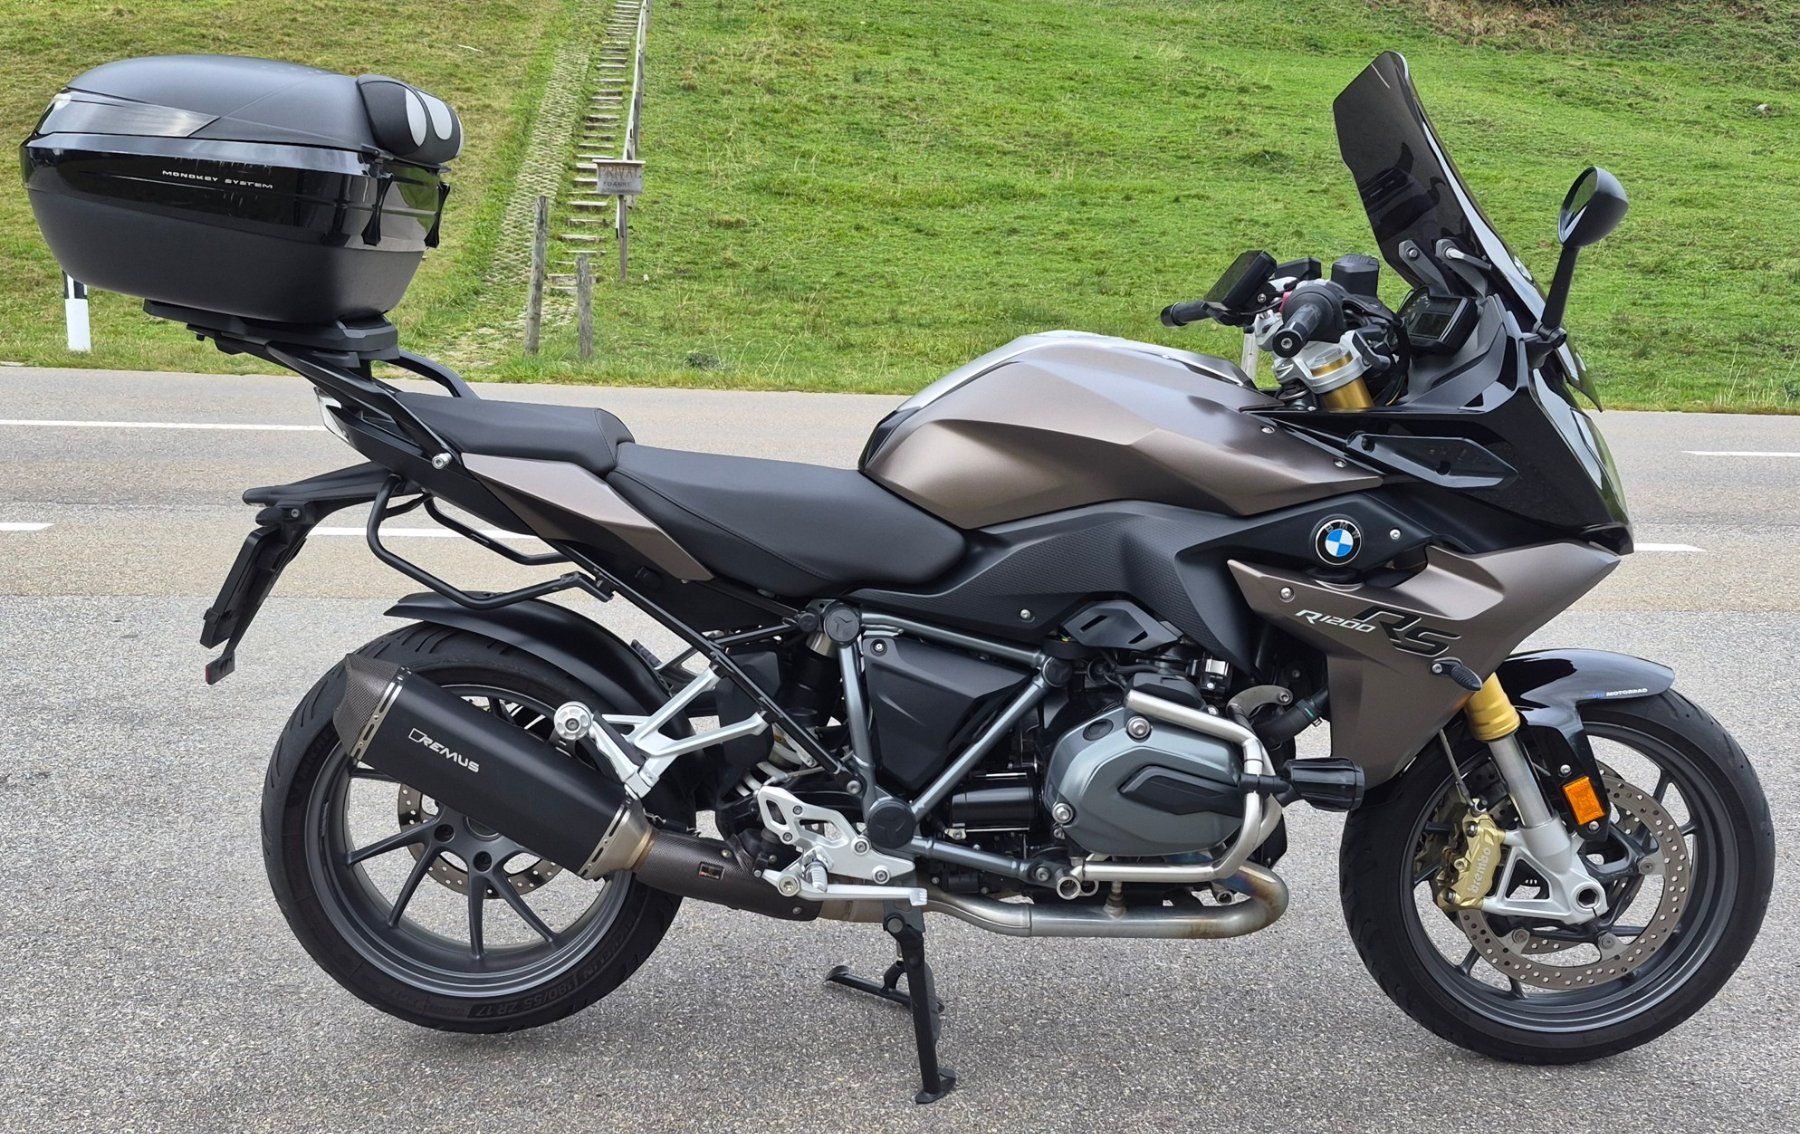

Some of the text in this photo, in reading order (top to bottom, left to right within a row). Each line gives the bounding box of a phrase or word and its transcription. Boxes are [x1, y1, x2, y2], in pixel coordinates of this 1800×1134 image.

[162, 170, 273, 189] MONOKEY SYSTEM
[1324, 521, 1361, 540] BMW
[1295, 605, 1462, 658] R1200 RS
[1606, 687, 1648, 697] MOTORRAD
[422, 735, 480, 773] REMUS
[1467, 847, 1492, 894] brembo
[475, 1004, 495, 1017] 17
